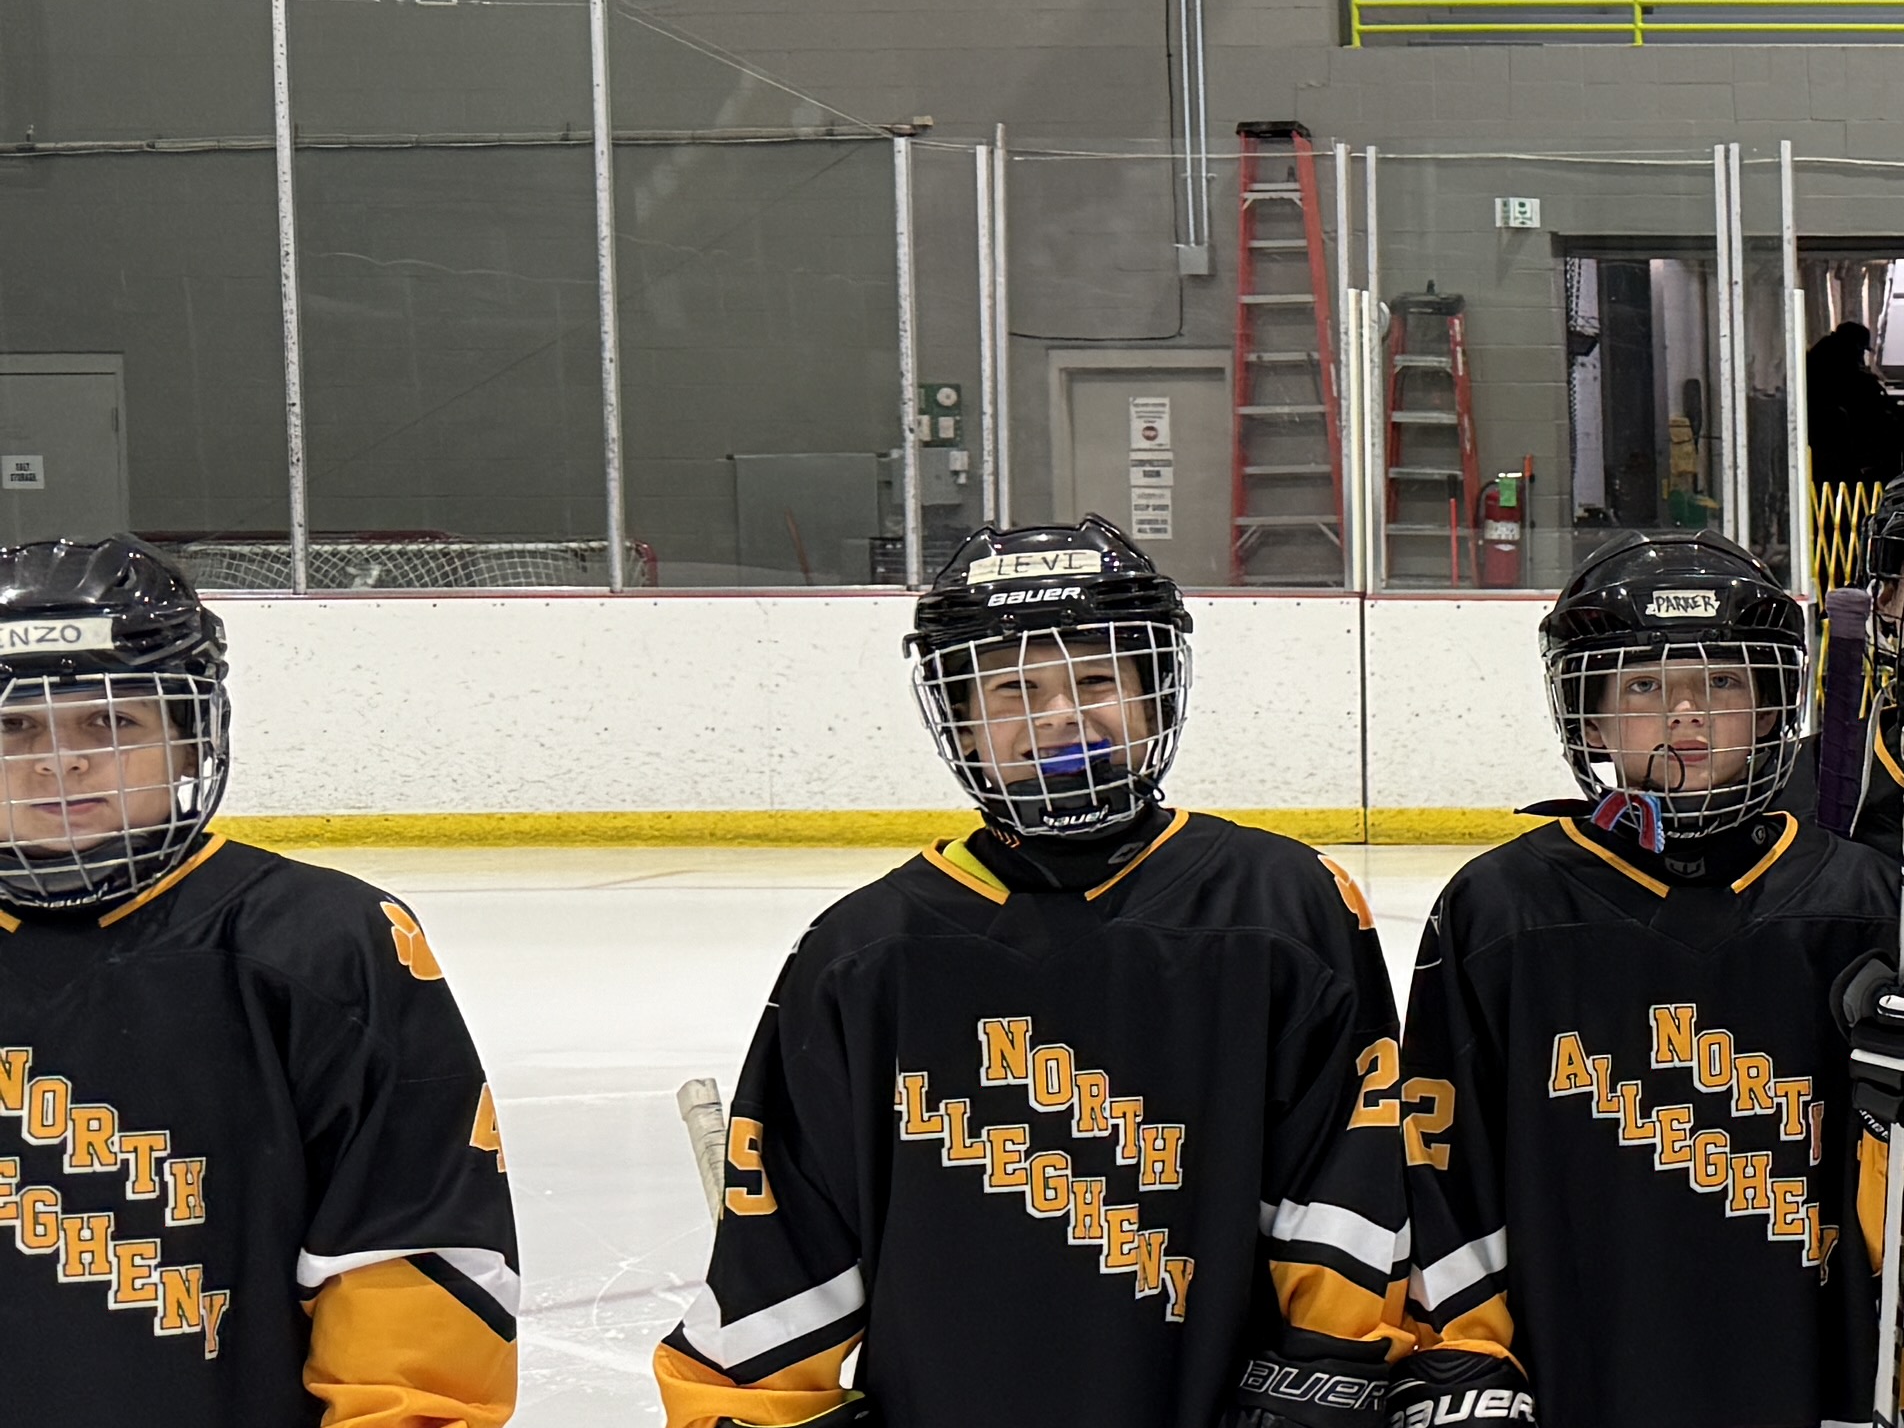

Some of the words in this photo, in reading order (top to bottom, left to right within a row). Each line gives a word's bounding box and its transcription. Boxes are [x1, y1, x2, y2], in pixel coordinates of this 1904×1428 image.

[987, 586, 1085, 608] BAUER
[996, 551, 1088, 577] LEVI
[1655, 592, 1717, 614] PARKER
[978, 1015, 1186, 1192] NORTH
[1346, 1036, 1402, 1131] 2
[1402, 1078, 1456, 1171] 2
[723, 1116, 778, 1217] 5
[895, 1054, 1196, 1323] LLEGHENY
[1239, 1359, 1389, 1413] AUER
